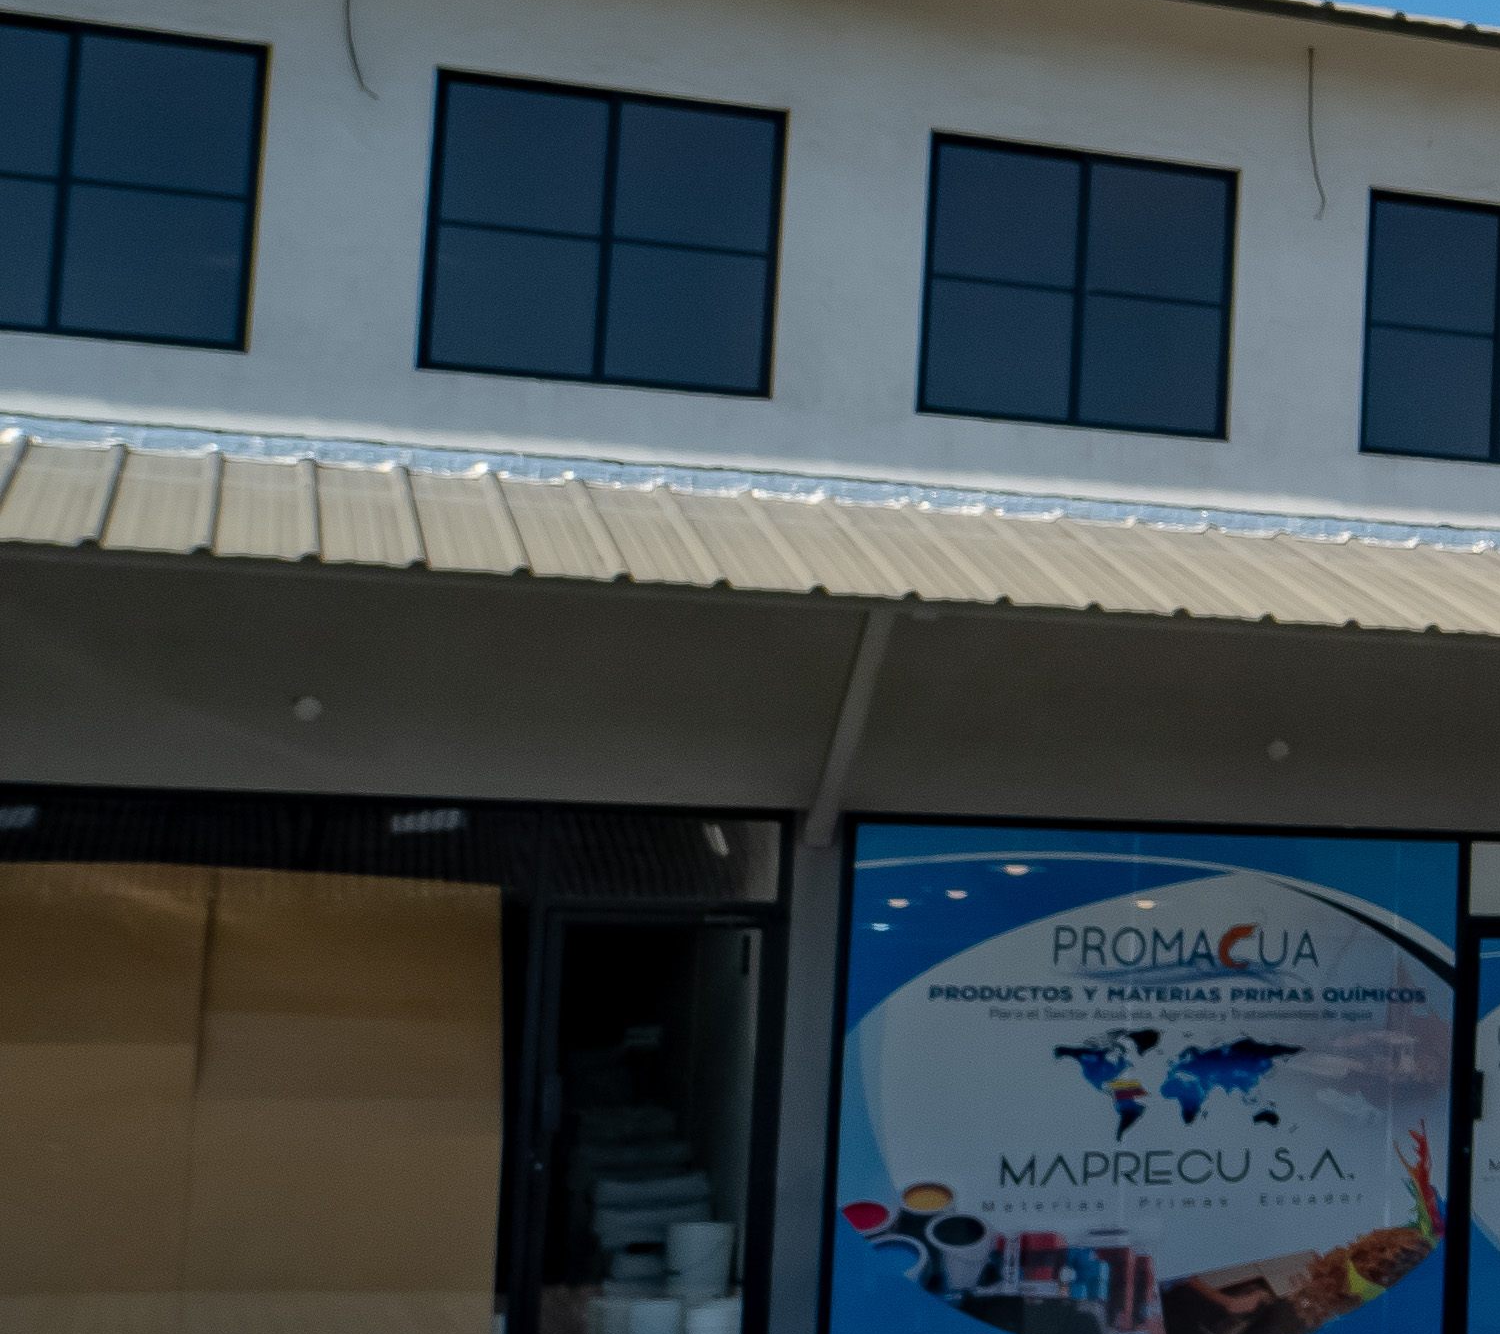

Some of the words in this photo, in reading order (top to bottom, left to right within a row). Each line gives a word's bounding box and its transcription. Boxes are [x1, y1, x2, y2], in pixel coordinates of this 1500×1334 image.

[1053, 924, 1320, 969] PROMACUA
[928, 985, 1072, 1003] PRODUCTOS
[1084, 986, 1096, 1003] Y
[1107, 986, 1221, 1003] MATERIAS
[1230, 986, 1314, 1004] PRIMAS
[1322, 985, 1427, 1004] QUÍMICOS
[1000, 1148, 1250, 1187] MAPRECU
[1268, 1146, 1355, 1182] S.A.
[981, 1198, 1105, 1212] Materias
[1138, 1194, 1229, 1210] Primas
[1259, 1192, 1363, 1207] Ecuador
